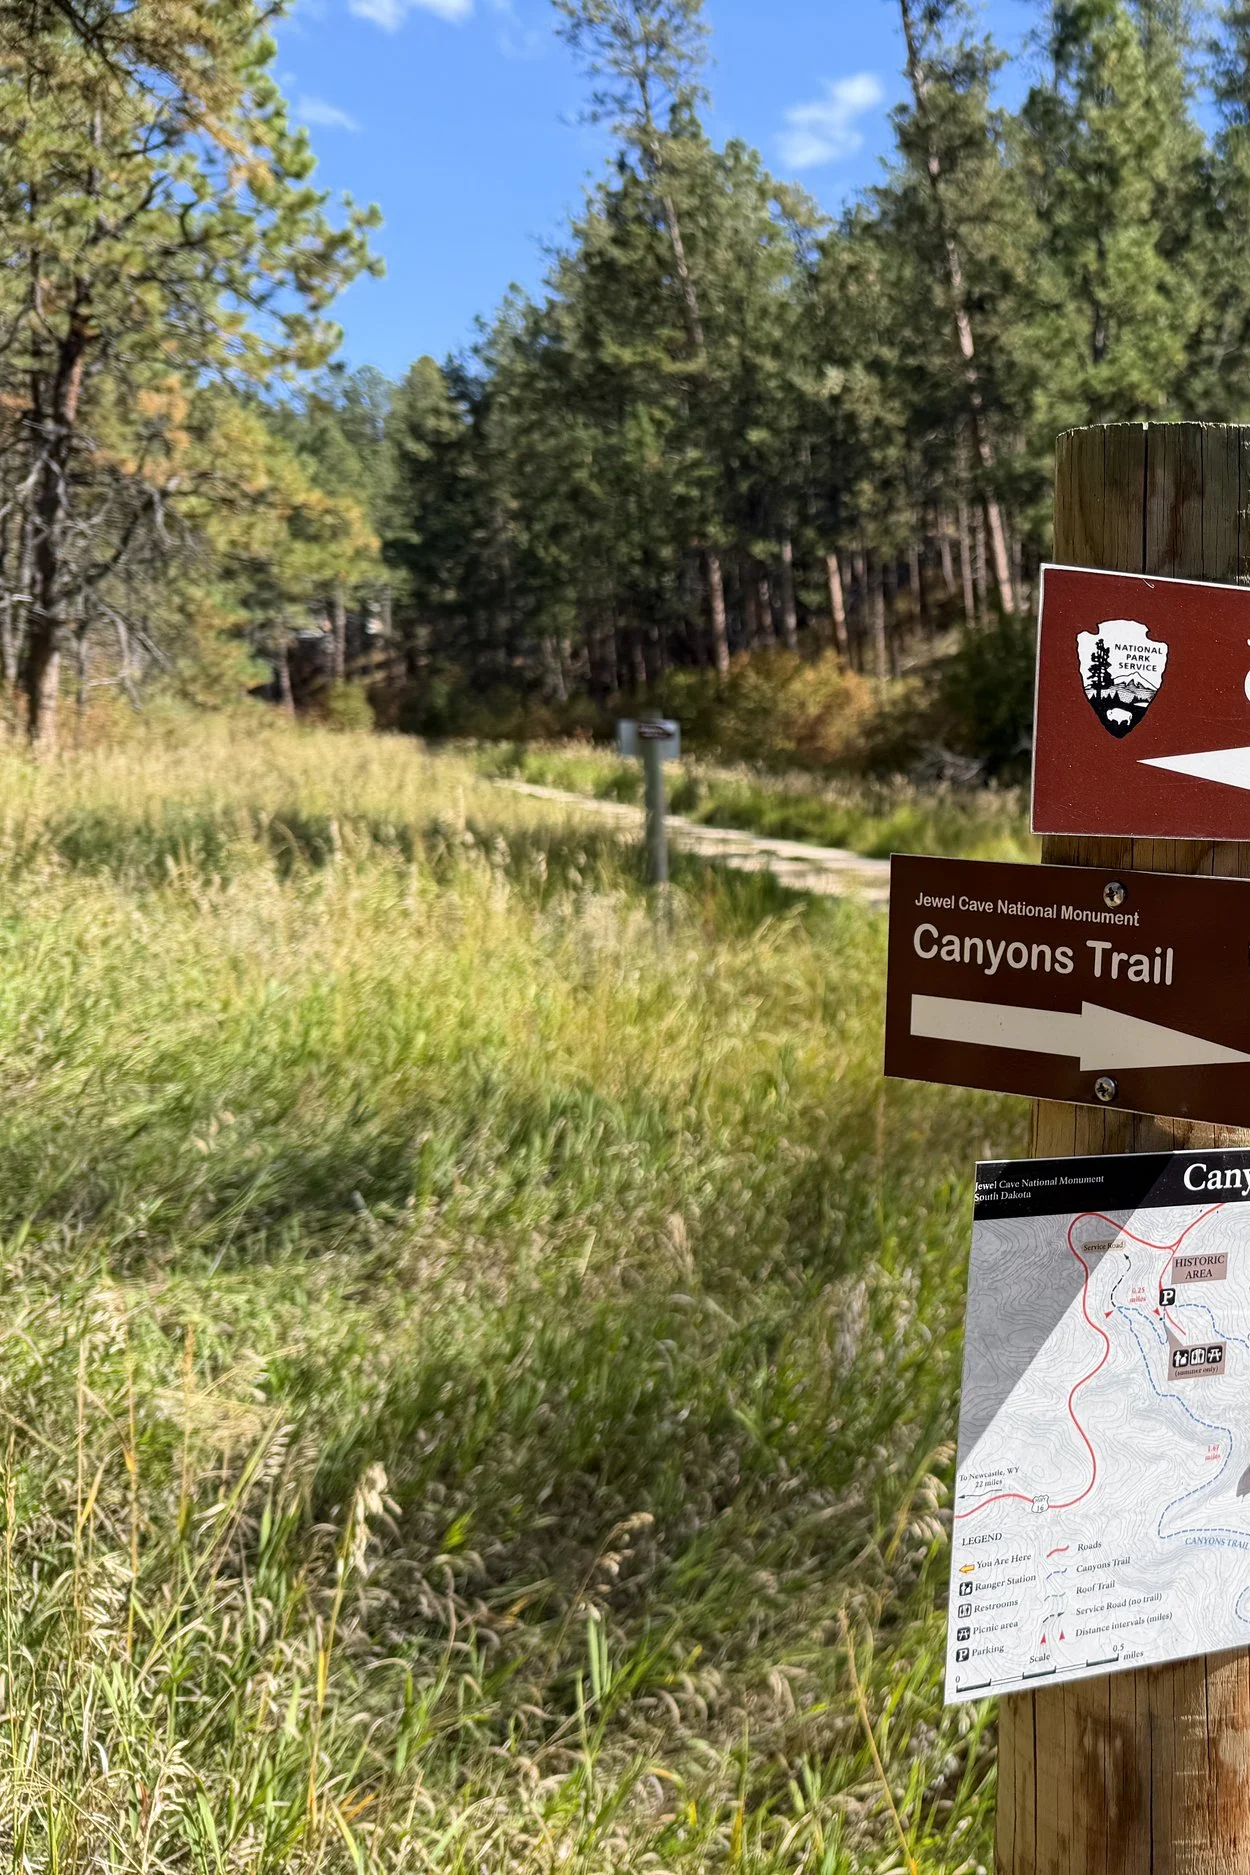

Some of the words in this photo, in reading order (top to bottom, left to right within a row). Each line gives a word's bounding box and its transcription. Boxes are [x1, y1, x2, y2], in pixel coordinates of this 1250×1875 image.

[1115, 644, 1162, 654] NATIONAL
[1126, 654, 1150, 662] PARK
[1119, 662, 1157, 672] SERVICE
[915, 892, 955, 910] Jewel
[959, 895, 993, 913] Cave
[997, 900, 1056, 918] National
[1061, 905, 1139, 926] Monument
[913, 923, 1074, 975] Canyons
[1087, 940, 1174, 985] Trail
[975, 1181, 996, 1191] Jewel
[999, 1180, 1019, 1188] Cave
[1022, 1177, 1057, 1187] National
[1059, 1176, 1104, 1185] Monument
[975, 1192, 998, 1202] South
[1001, 1191, 1031, 1199] Dakota
[1084, 1242, 1106, 1251] Service
[1107, 1241, 1123, 1250] Road
[1175, 1255, 1224, 1268] HISTORIC
[1185, 1269, 1213, 1279] AREA
[1162, 1290, 1173, 1304] P
[969, 1469, 1005, 1480] Newcastle,
[1007, 1466, 1020, 1474] WY
[985, 1479, 1002, 1487] miles
[962, 1532, 1002, 1546] LEGEND
[1078, 1541, 1102, 1551] Roads
[1185, 1537, 1226, 1546] CANYONS
[1227, 1538, 1249, 1550] TRAIL
[977, 1559, 992, 1569] You
[993, 1557, 1009, 1566] Are
[1010, 1554, 1031, 1563] Here
[1076, 1562, 1109, 1574] Canyons
[1111, 1557, 1130, 1566] Trail
[975, 1581, 1005, 1592] Ranger
[1007, 1574, 1036, 1586] Station
[1076, 1585, 1096, 1595] Roof
[1097, 1580, 1115, 1590] Trail
[974, 1599, 1019, 1613] Restrooms
[1076, 1605, 1105, 1616] Service
[1106, 1599, 1127, 1610] Road
[1128, 1598, 1142, 1608] (no
[1143, 1592, 1163, 1603] trail)
[973, 1624, 999, 1635] Picnic
[1000, 1620, 1018, 1629] area
[1075, 1624, 1110, 1637] Distance
[1111, 1616, 1145, 1630] intervals
[1146, 1612, 1173, 1624] (miles)
[972, 1644, 1004, 1658] Parking
[1112, 1643, 1124, 1652] 0.5
[1029, 1653, 1050, 1664] Scale
[1123, 1650, 1144, 1660] miles
[955, 1675, 960, 1683] 0
